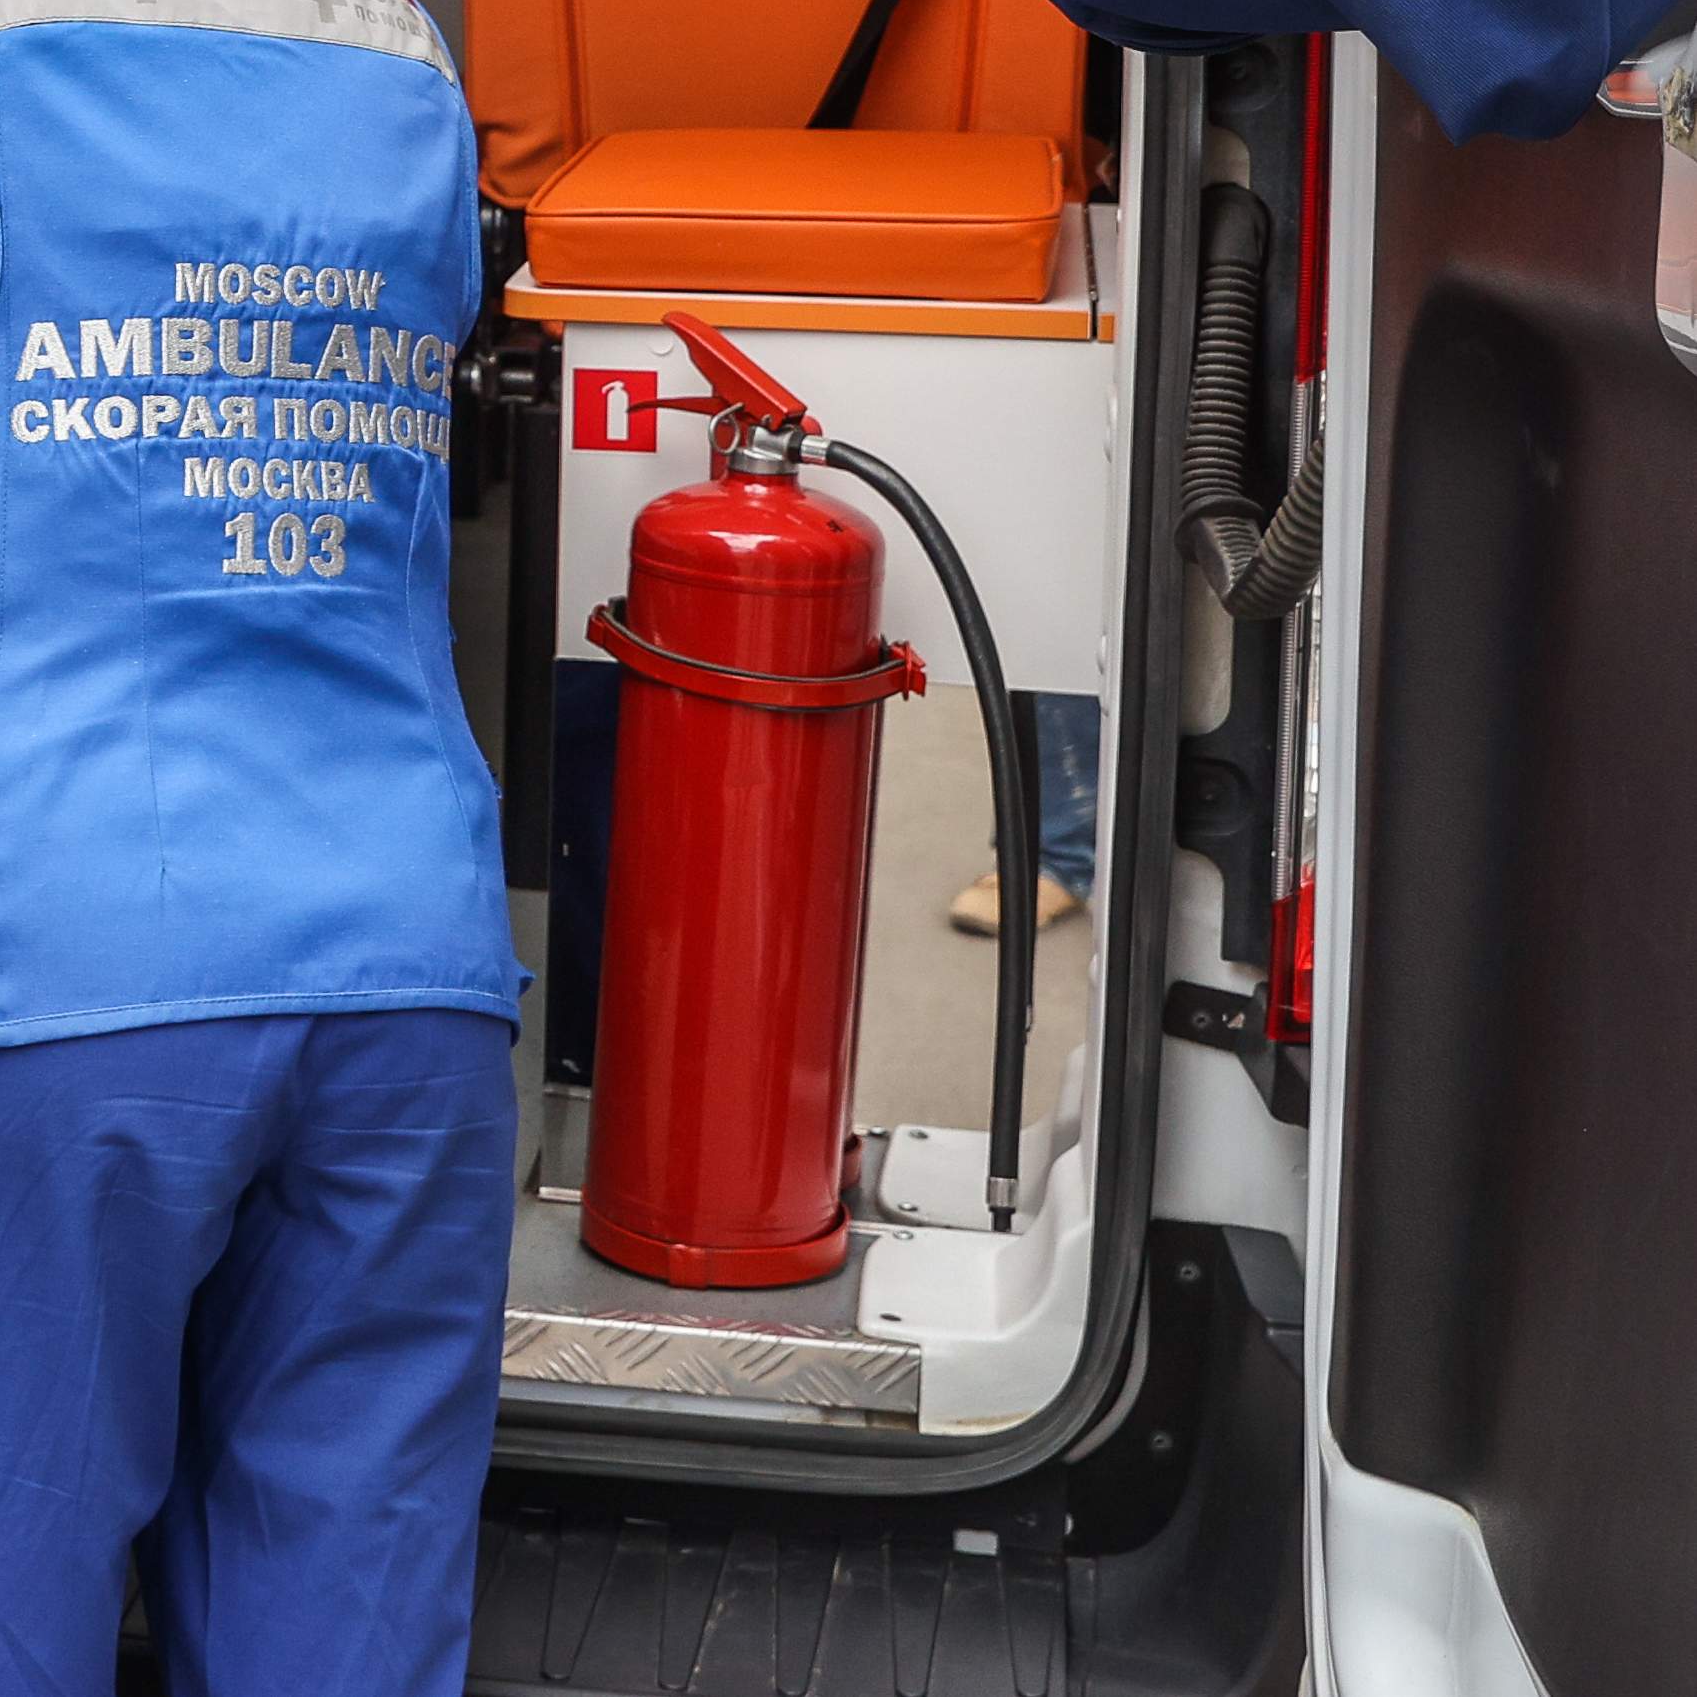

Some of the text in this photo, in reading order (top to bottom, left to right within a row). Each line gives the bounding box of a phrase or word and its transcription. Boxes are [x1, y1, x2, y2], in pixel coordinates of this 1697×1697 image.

[174, 262, 384, 311] MOSCOW
[10, 394, 451, 465] СКОРАЯ ПОМОЩ
[183, 456, 376, 503] МОСКВА
[222, 512, 347, 578] 103
